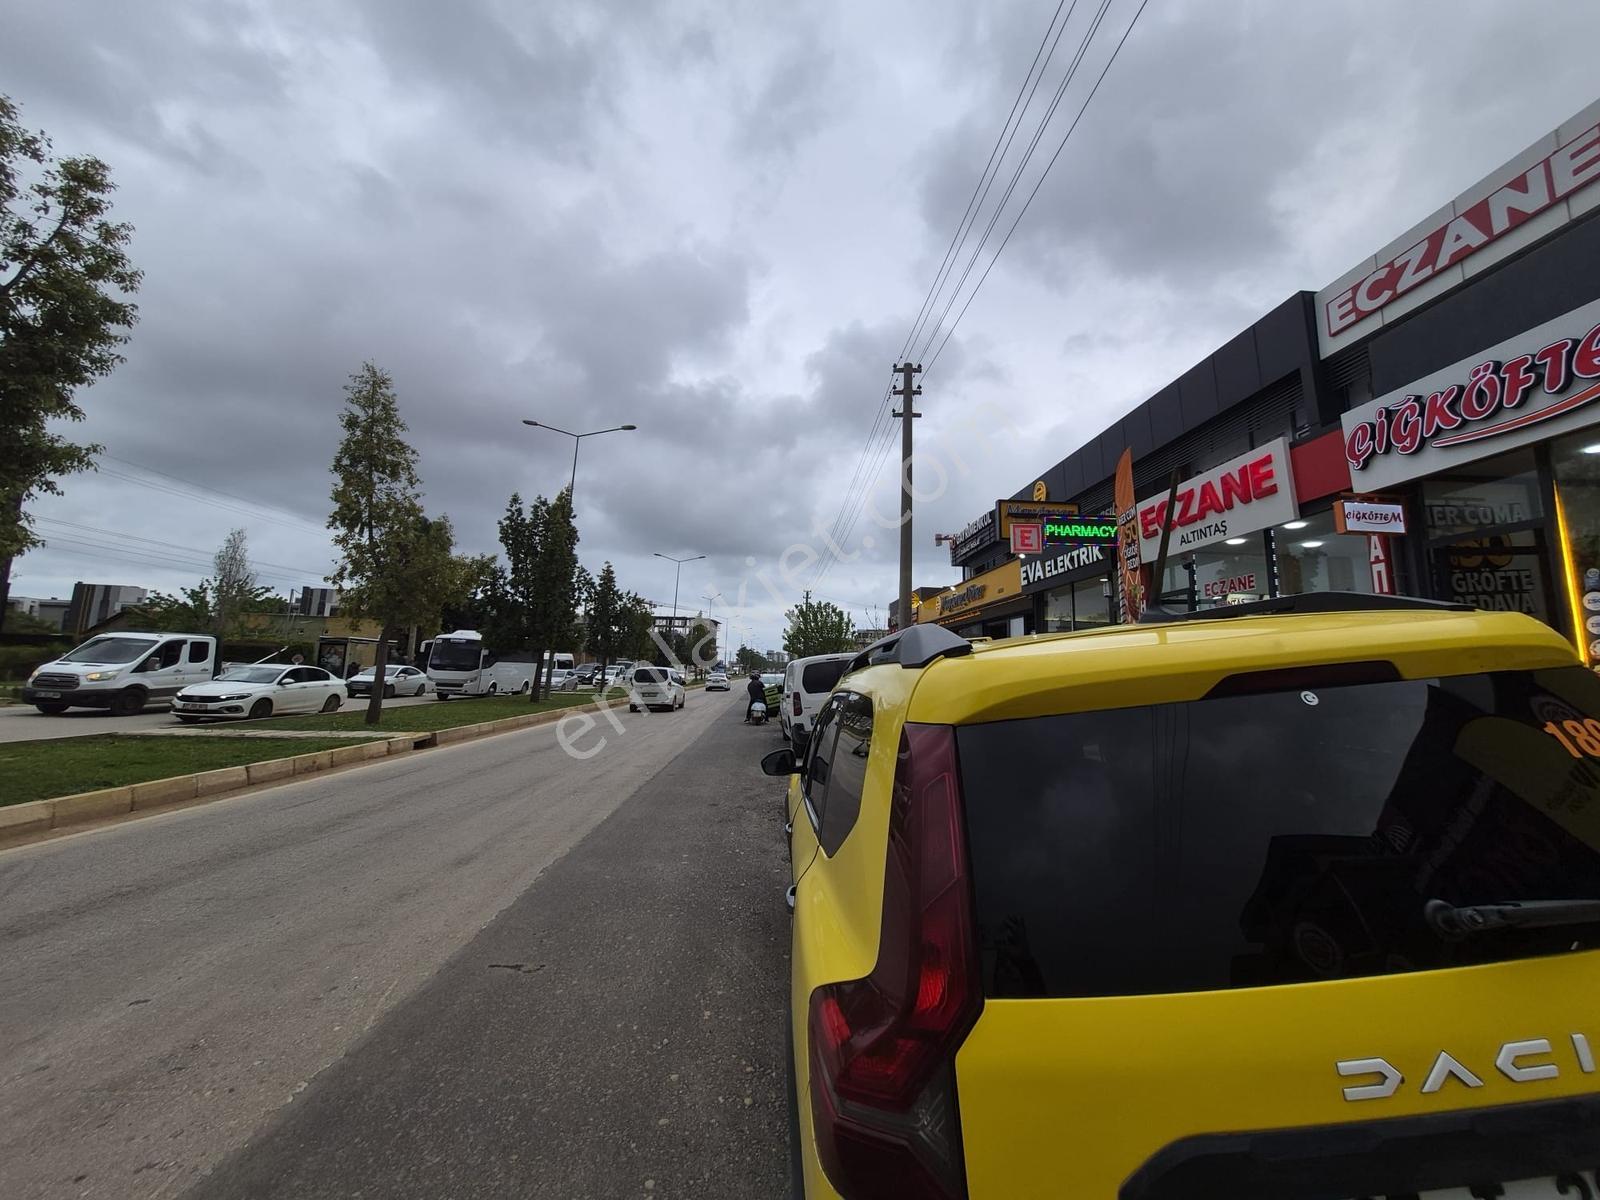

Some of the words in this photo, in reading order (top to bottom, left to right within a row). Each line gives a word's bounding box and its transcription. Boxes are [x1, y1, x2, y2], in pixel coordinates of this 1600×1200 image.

[1327, 124, 1600, 335] ECZANE
[1020, 529, 1033, 547] E
[1046, 524, 1117, 538] PHARMACY
[1179, 520, 1228, 546] ALTINTAŞ
[1020, 560, 1044, 586] EVA
[1204, 574, 1256, 597] ECZANE
